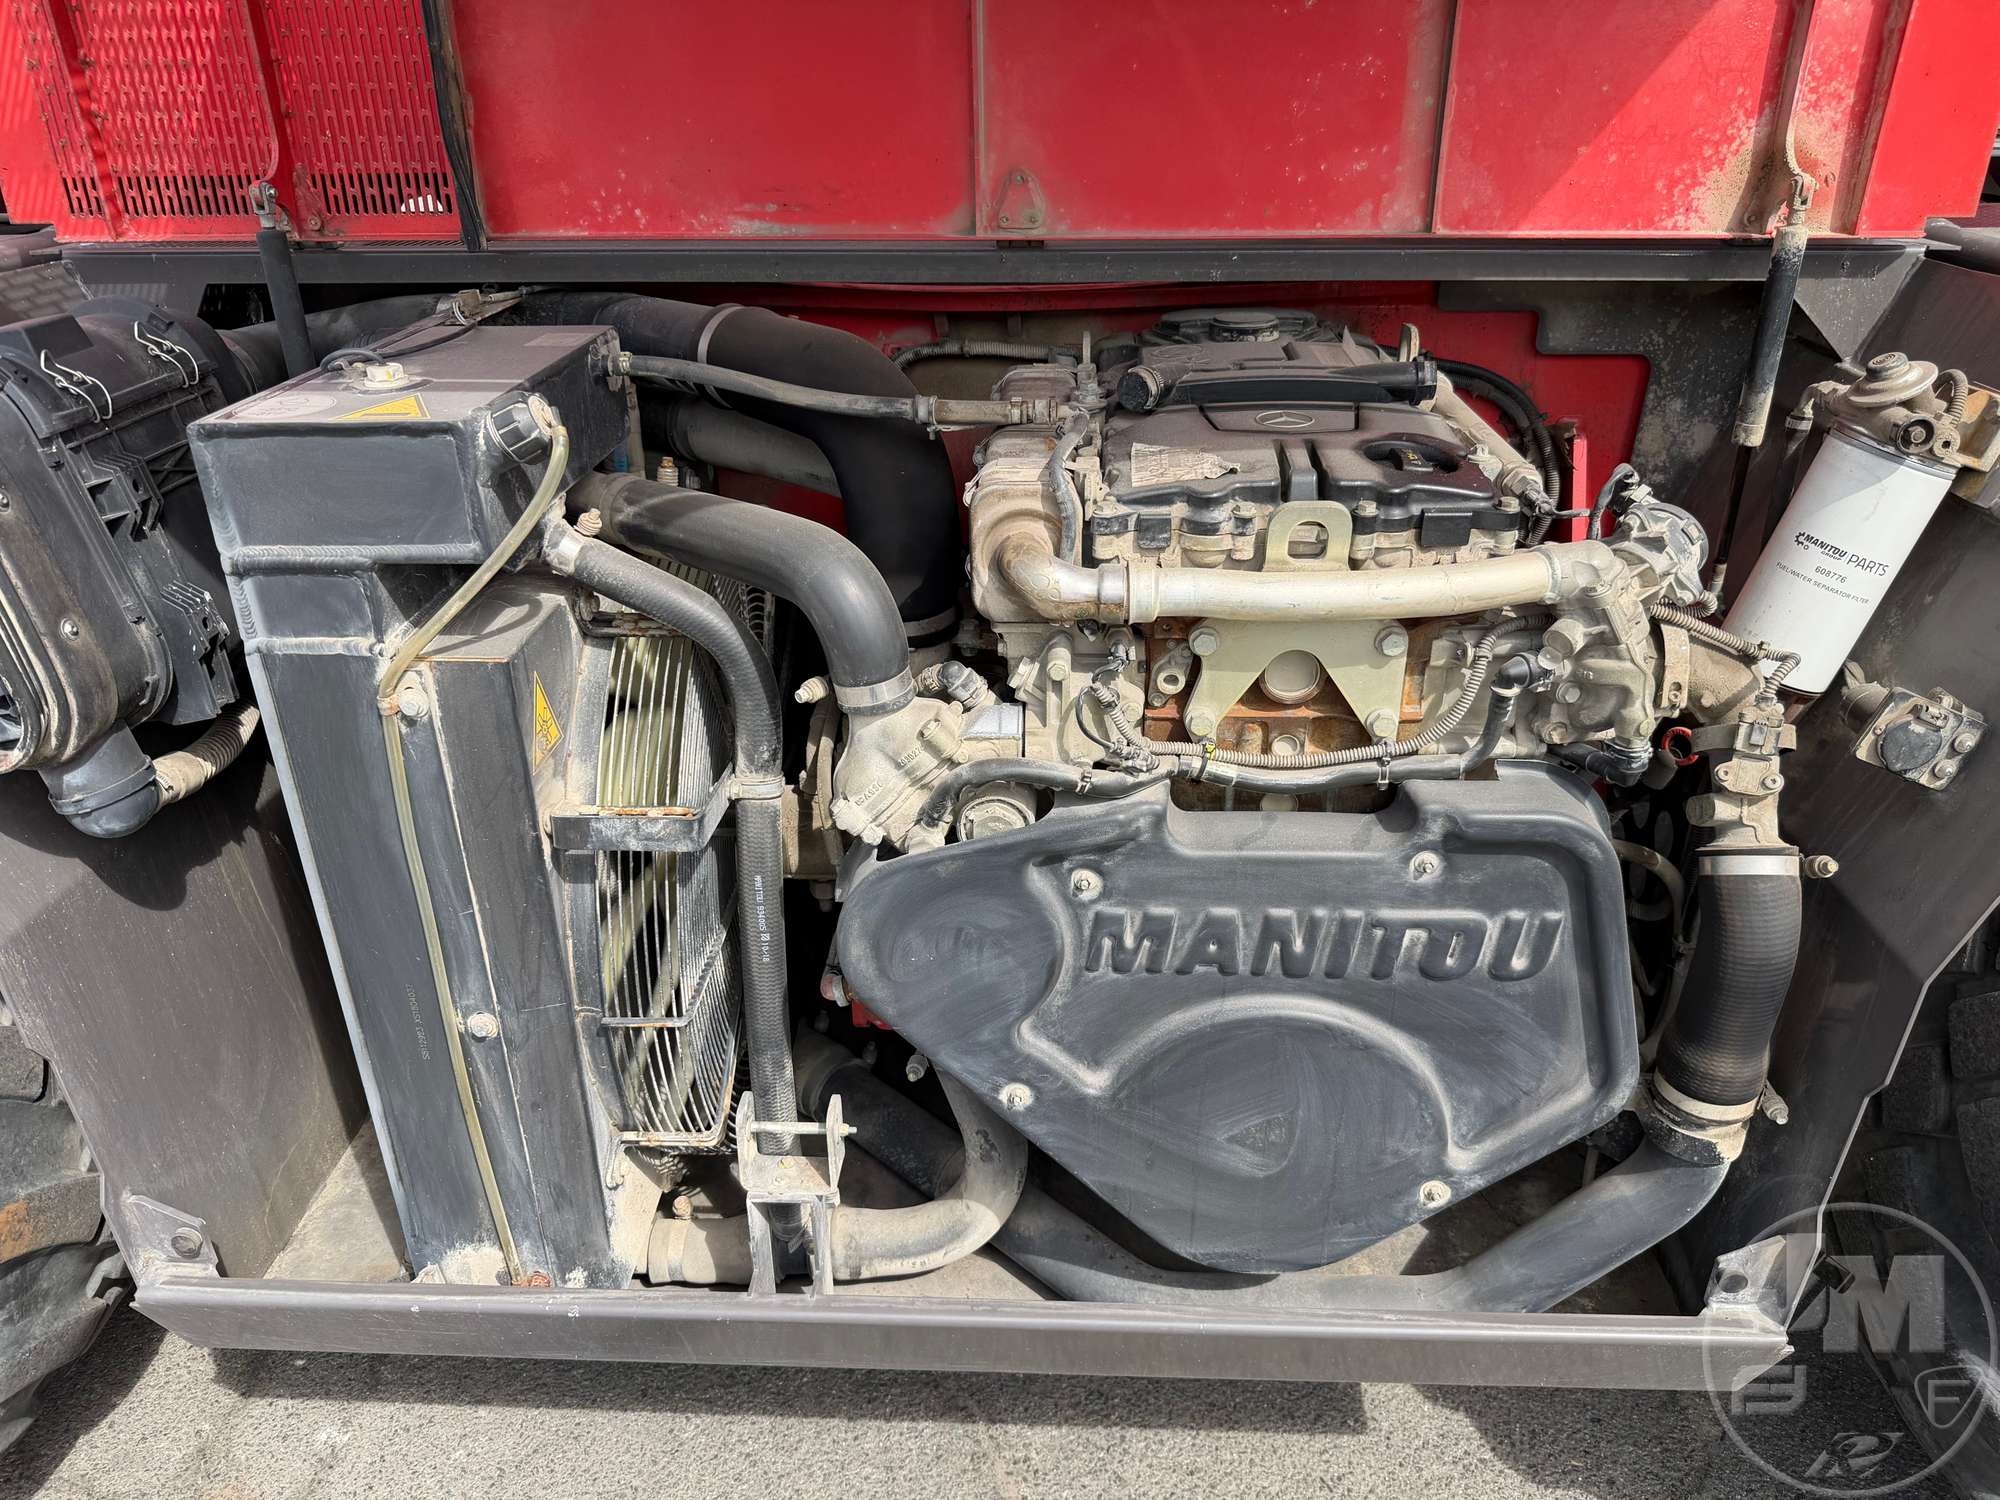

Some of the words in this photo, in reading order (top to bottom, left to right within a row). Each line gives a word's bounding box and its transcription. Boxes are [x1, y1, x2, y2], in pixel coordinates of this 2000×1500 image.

[1803, 533, 1848, 558] MANITOU
[1846, 553, 1889, 577] PARTS
[1820, 550, 1842, 561] GROUP
[1814, 565, 1848, 584] 608776
[1813, 580, 1852, 600] SEPARATOR
[1083, 907, 1566, 981] MANITOU
